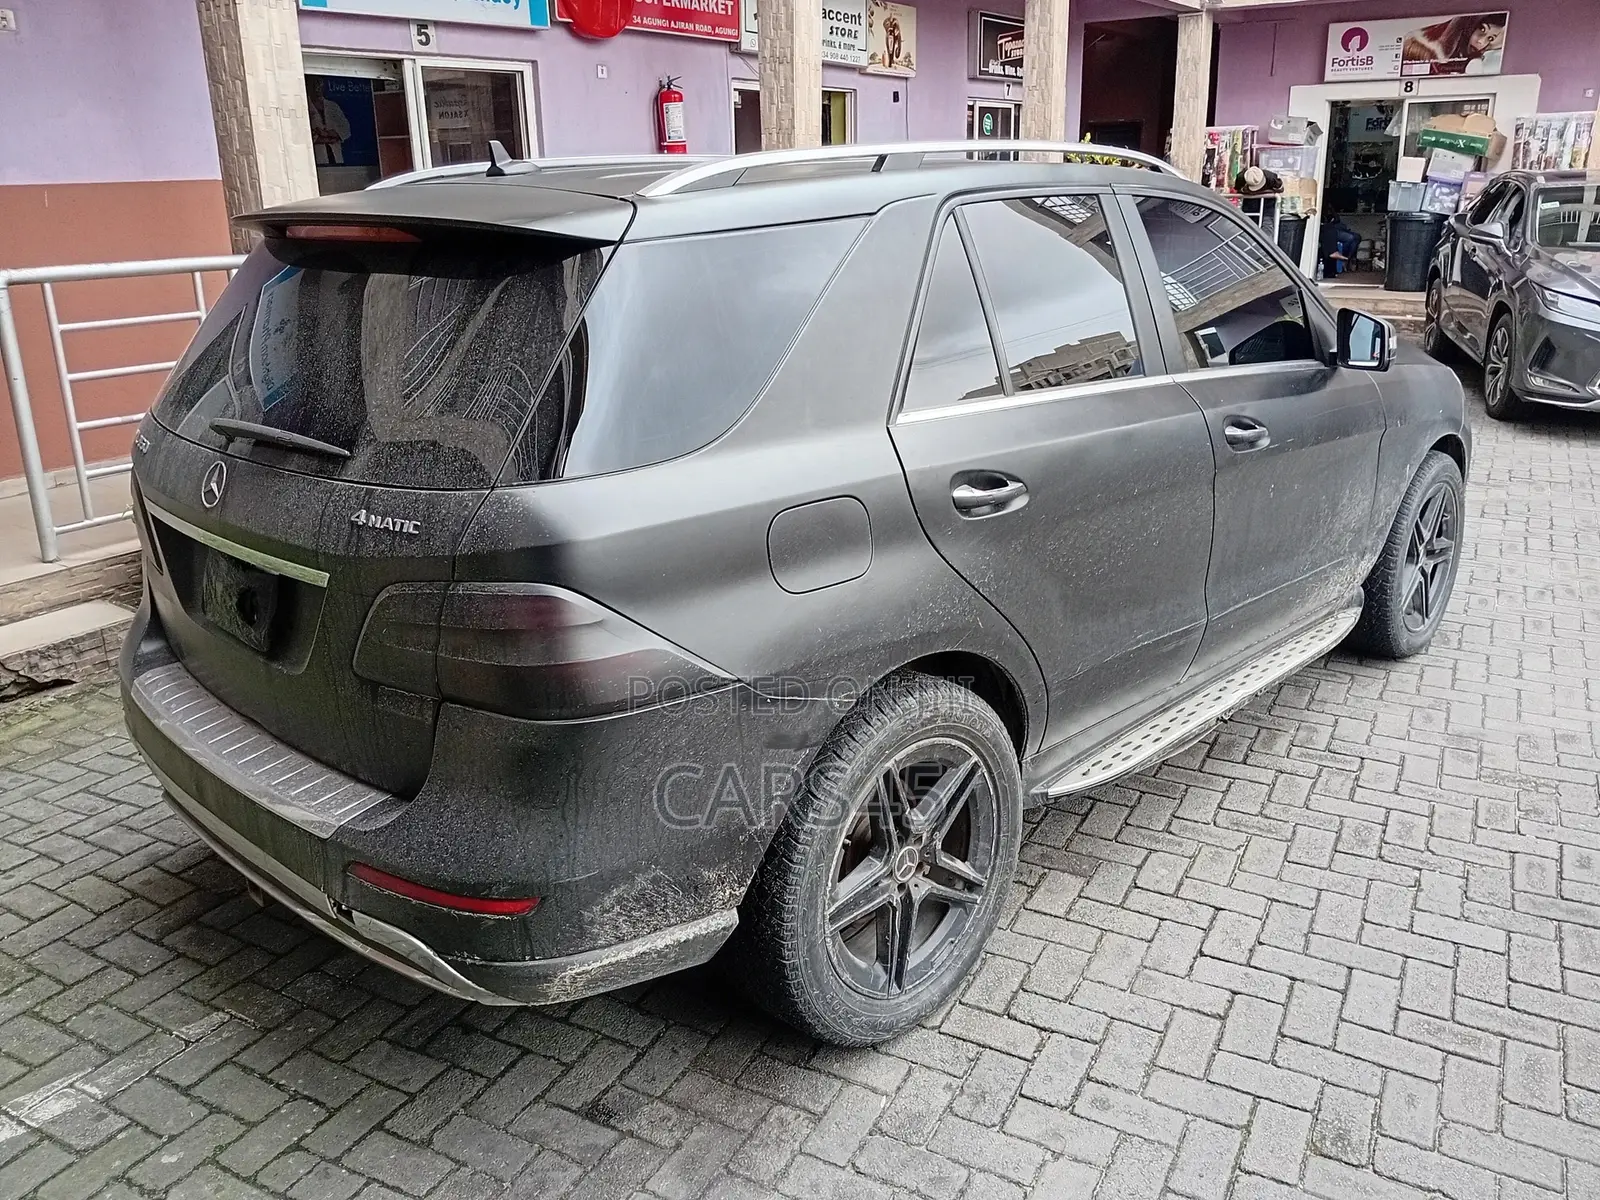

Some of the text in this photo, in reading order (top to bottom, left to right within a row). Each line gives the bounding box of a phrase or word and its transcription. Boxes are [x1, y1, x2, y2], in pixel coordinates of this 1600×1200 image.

[635, 0, 734, 16] RMARKET
[822, 8, 862, 26] accent
[632, 15, 641, 24] 34
[642, 16, 669, 28] AGUNGI
[695, 24, 715, 35] ROAD,
[715, 26, 738, 37] AGUNGI
[829, 25, 859, 39] STORE
[416, 24, 431, 46] 5
[1331, 55, 1374, 67] FortisB
[1006, 84, 1011, 96] 7
[1403, 81, 1414, 93] 8
[350, 509, 421, 535] 4MATIC
